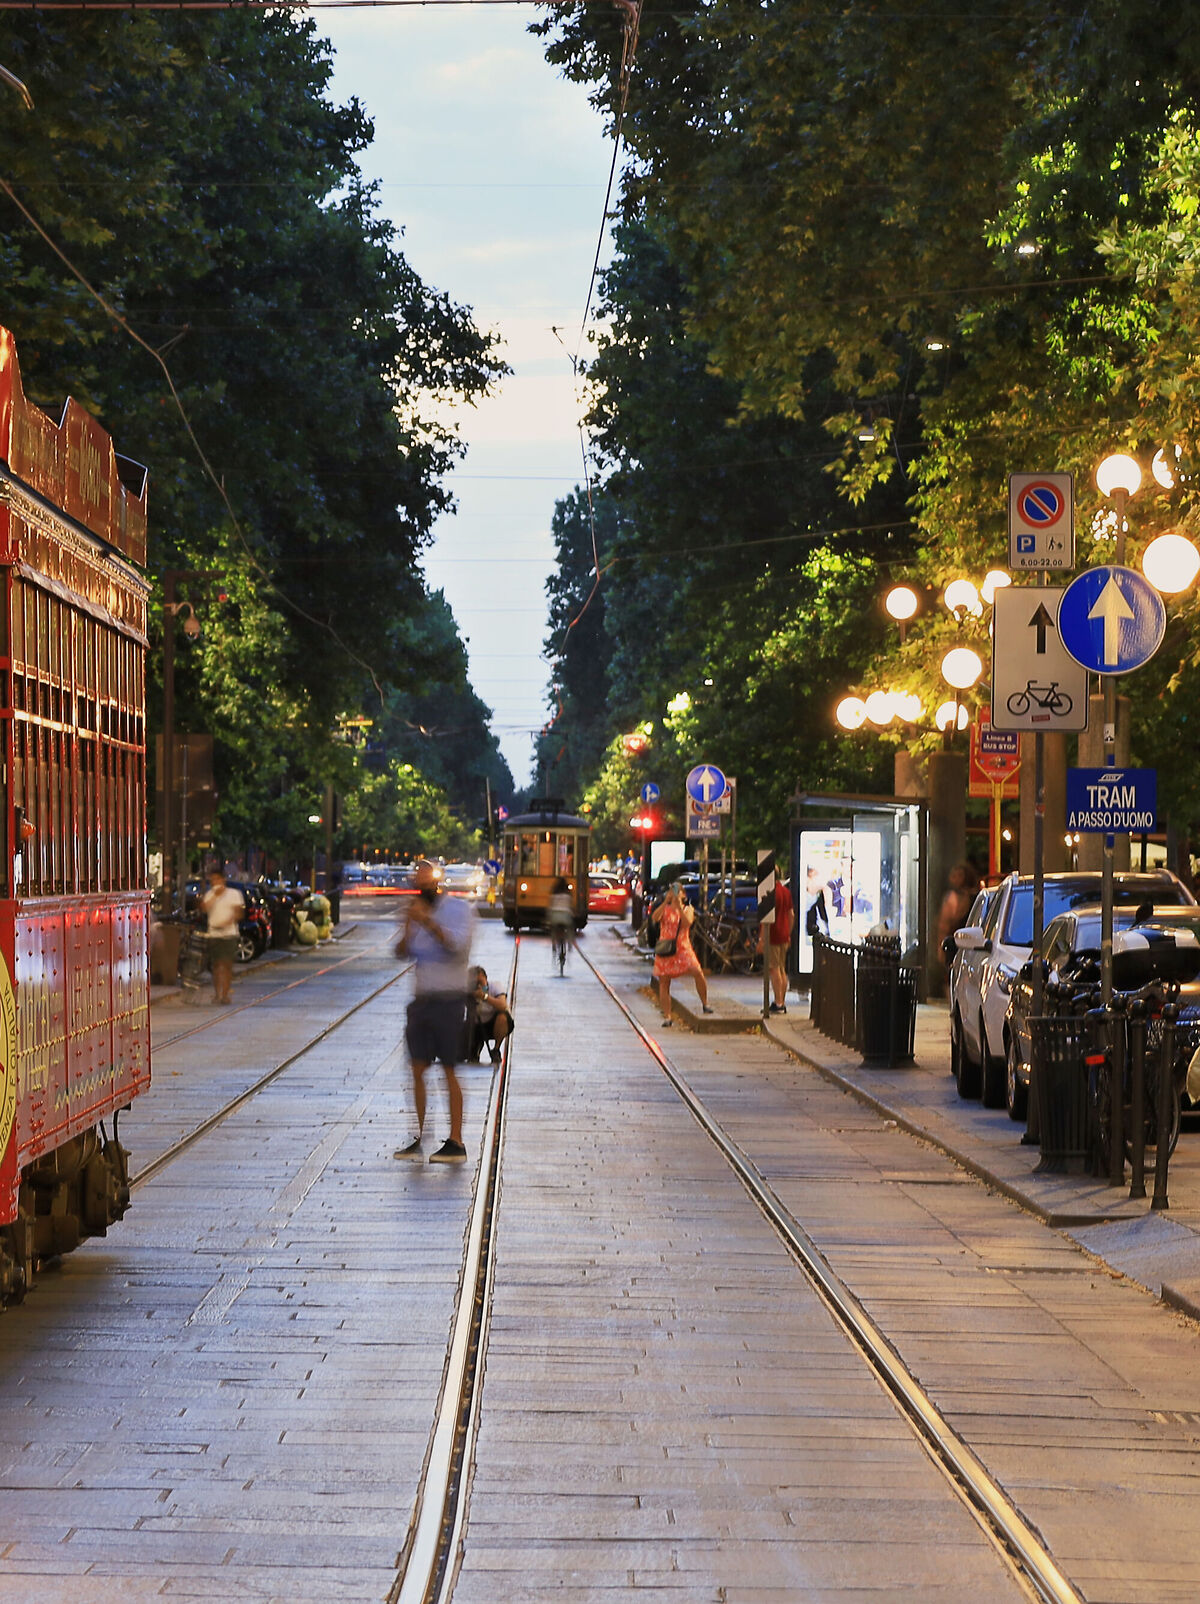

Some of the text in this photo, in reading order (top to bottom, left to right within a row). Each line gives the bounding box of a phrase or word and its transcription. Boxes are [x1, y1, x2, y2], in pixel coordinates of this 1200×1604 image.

[999, 743, 1017, 751] STOP
[1086, 785, 1136, 809] TRAM
[1069, 811, 1153, 828] A PASSO D'UOMO
